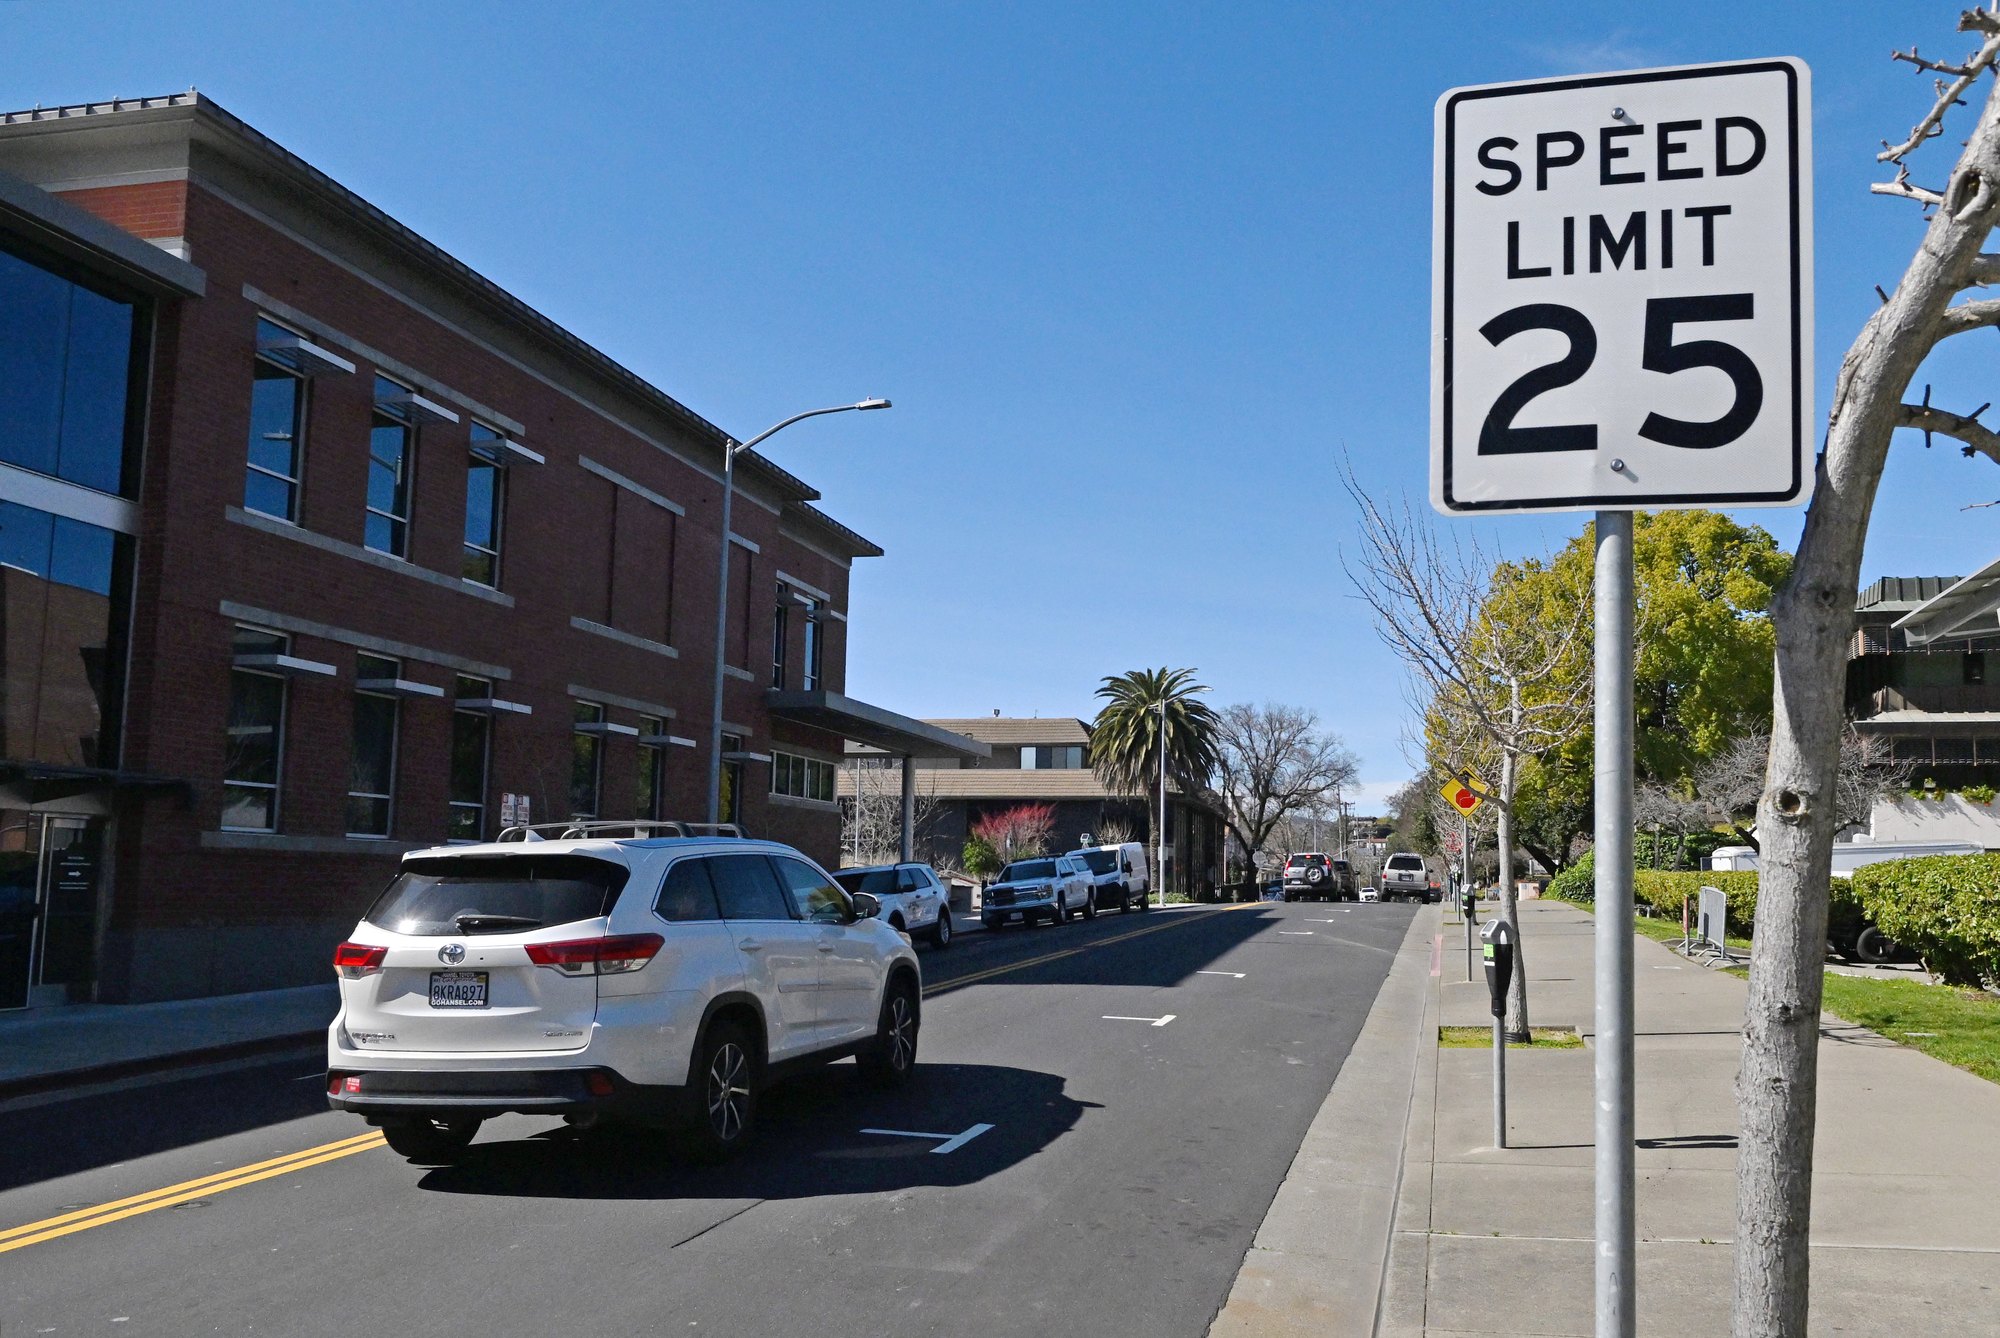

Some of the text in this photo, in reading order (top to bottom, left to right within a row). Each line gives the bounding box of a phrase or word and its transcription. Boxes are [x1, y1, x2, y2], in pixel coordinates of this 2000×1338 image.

[1475, 115, 1767, 196] SPEED
[1507, 205, 1732, 280] LIMIT
[1477, 292, 1764, 456] 25
[433, 985, 483, 1000] 8KRA897
